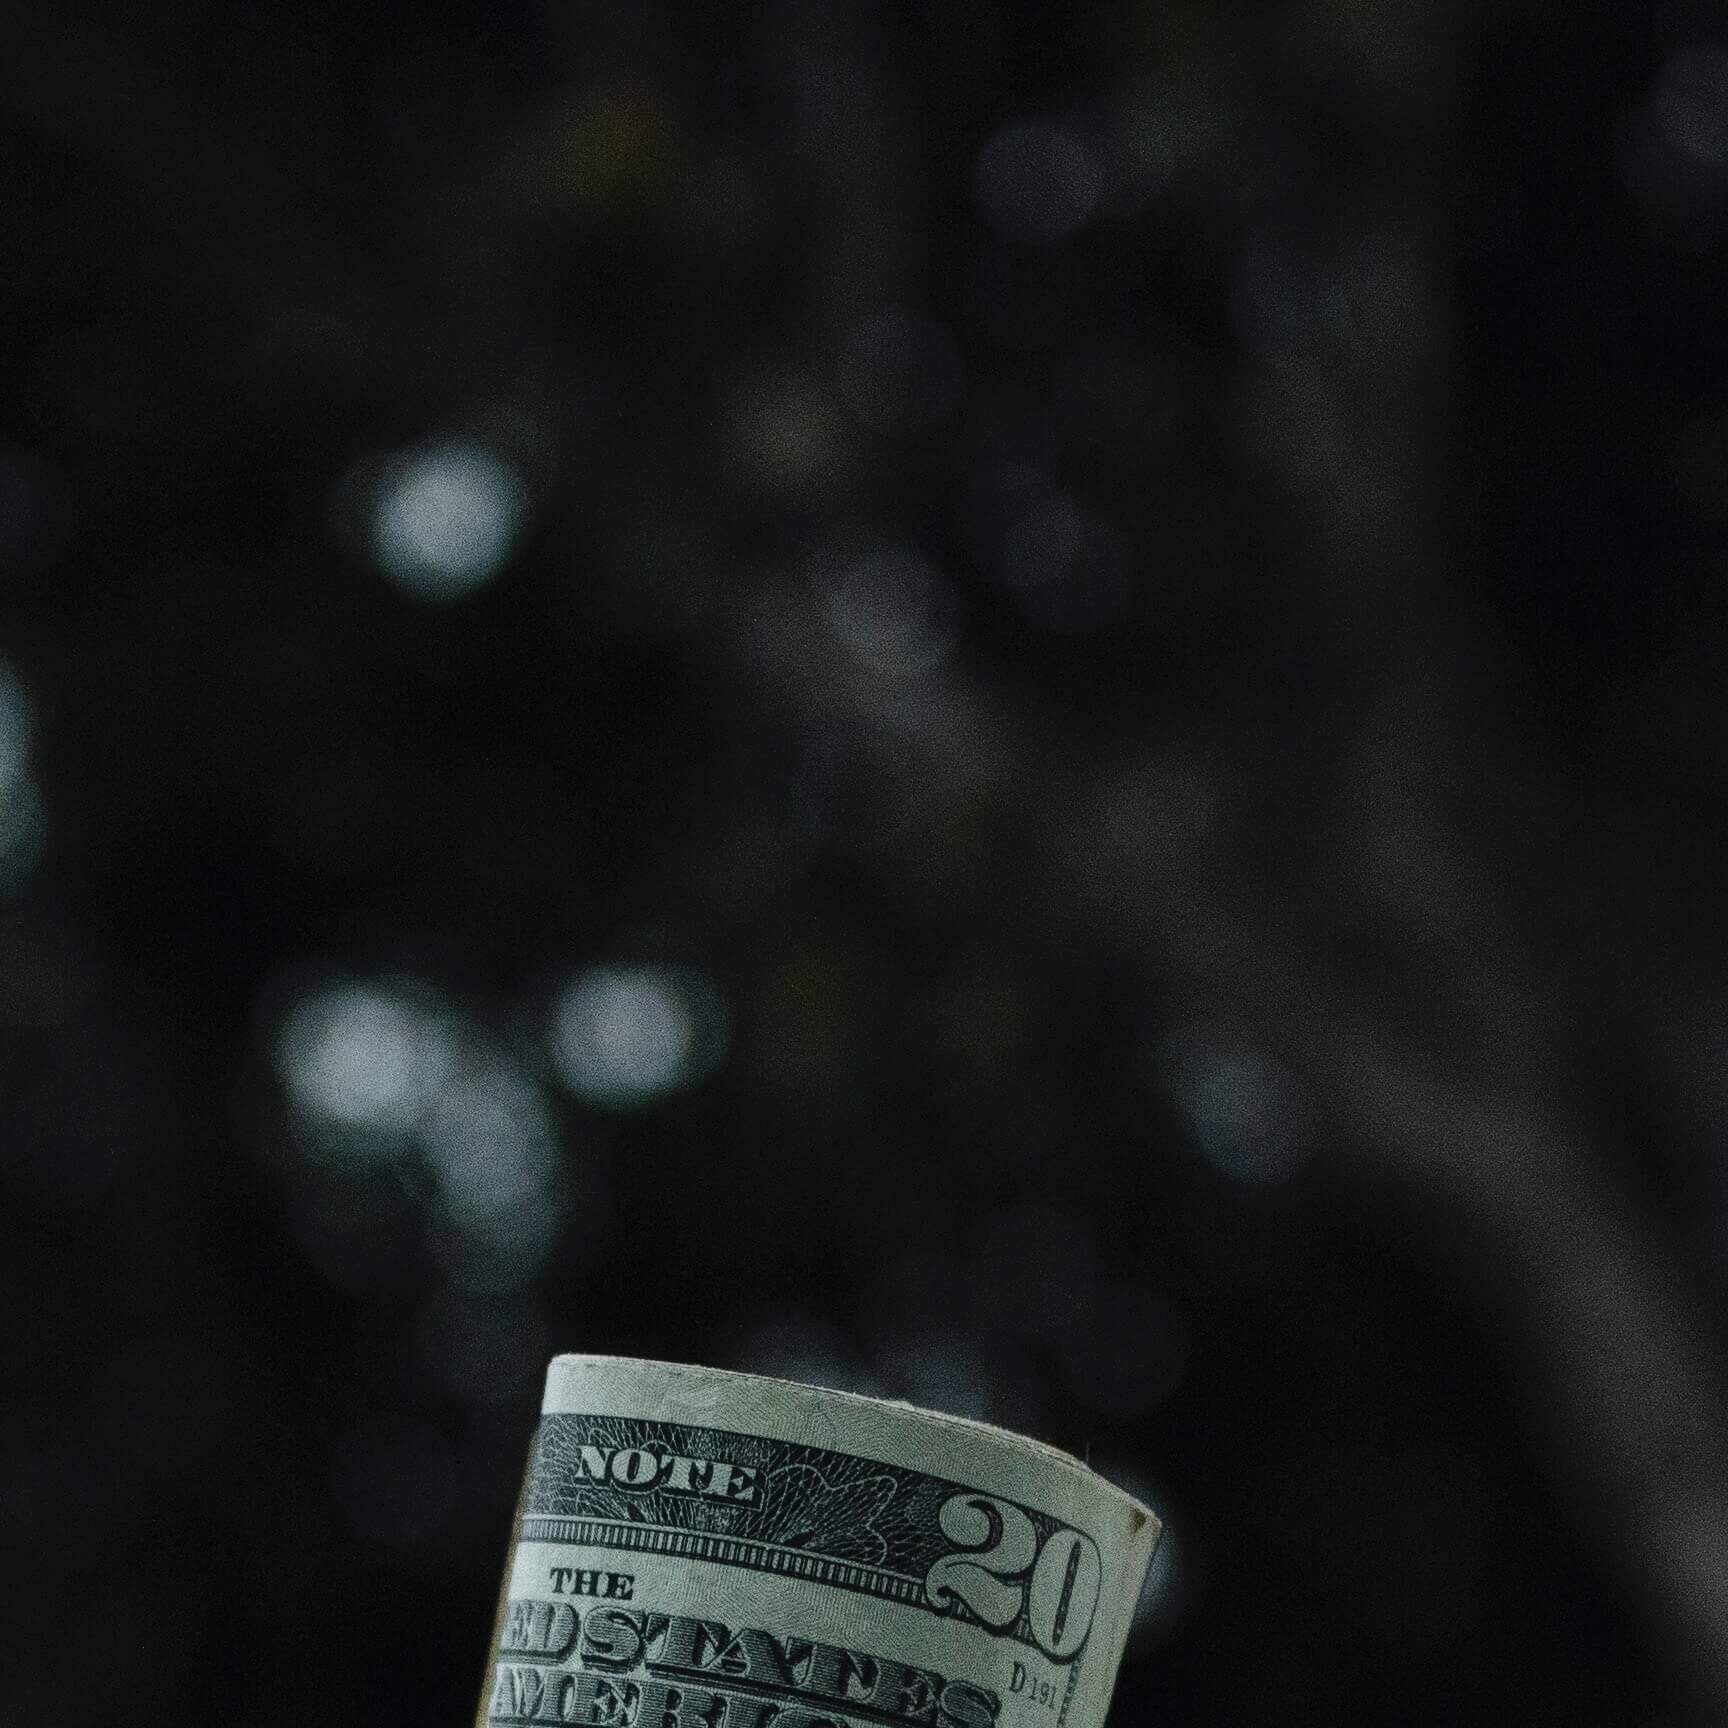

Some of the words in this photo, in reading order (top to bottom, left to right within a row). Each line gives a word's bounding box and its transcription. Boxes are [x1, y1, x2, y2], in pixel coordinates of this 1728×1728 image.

[573, 1443, 762, 1505] NOTE
[550, 1566, 636, 1601] THE
[924, 1493, 1101, 1663] 20
